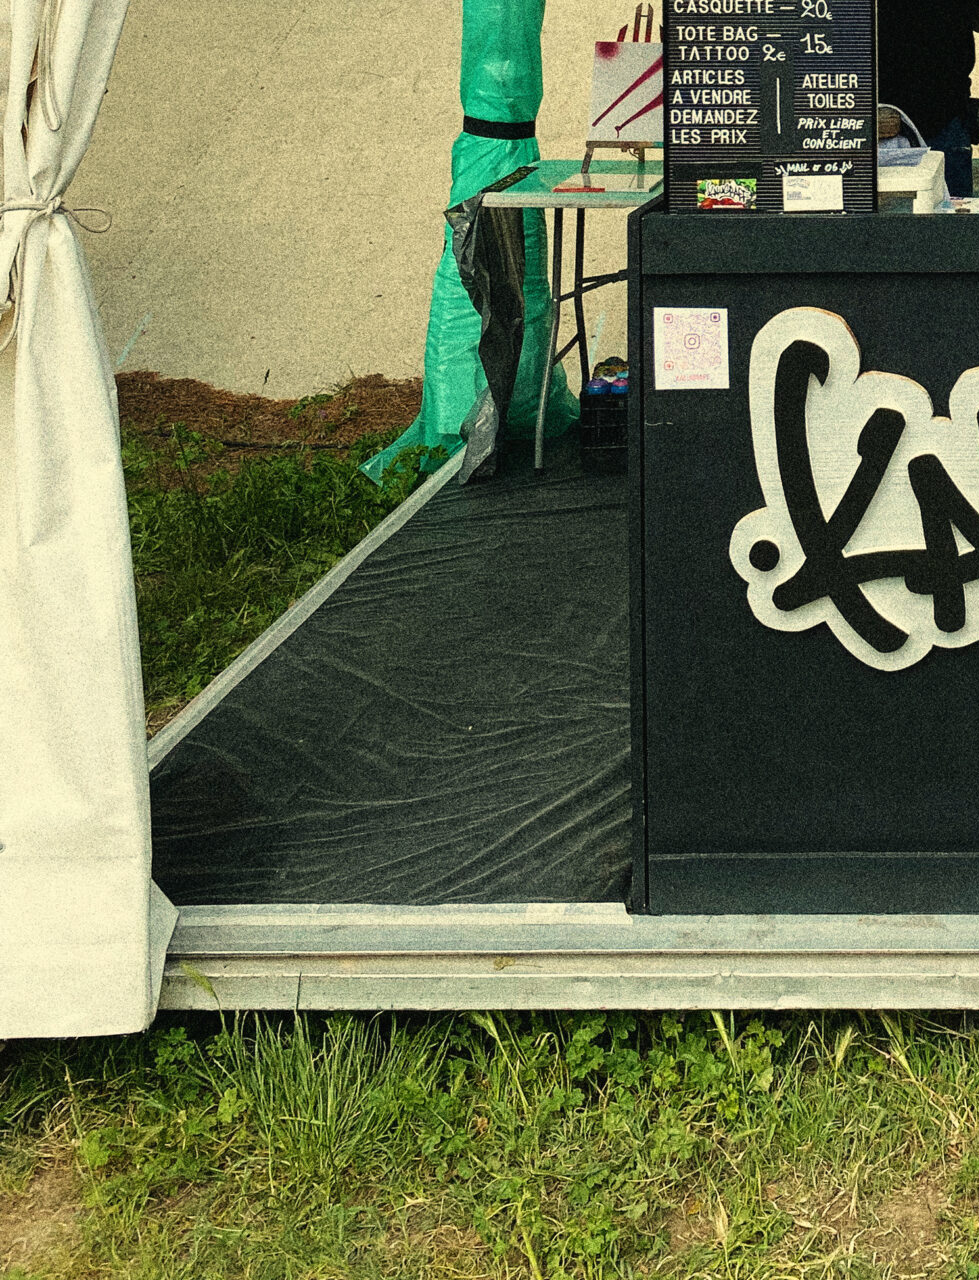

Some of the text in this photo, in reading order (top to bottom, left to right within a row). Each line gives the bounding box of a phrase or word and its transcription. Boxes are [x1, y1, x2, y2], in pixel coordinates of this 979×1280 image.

[676, 26, 716, 41] TOTE
[723, 26, 758, 41] BAG
[679, 45, 750, 61] TATTOO
[671, 69, 745, 85] ARTICLES
[802, 74, 859, 89] ATELIER
[672, 89, 752, 105] A VENDRE
[807, 93, 855, 109] TOILES
[670, 109, 758, 125] DEMANDEZ
[672, 129, 747, 144] LES PRIX
[822, 129, 840, 139] ET
